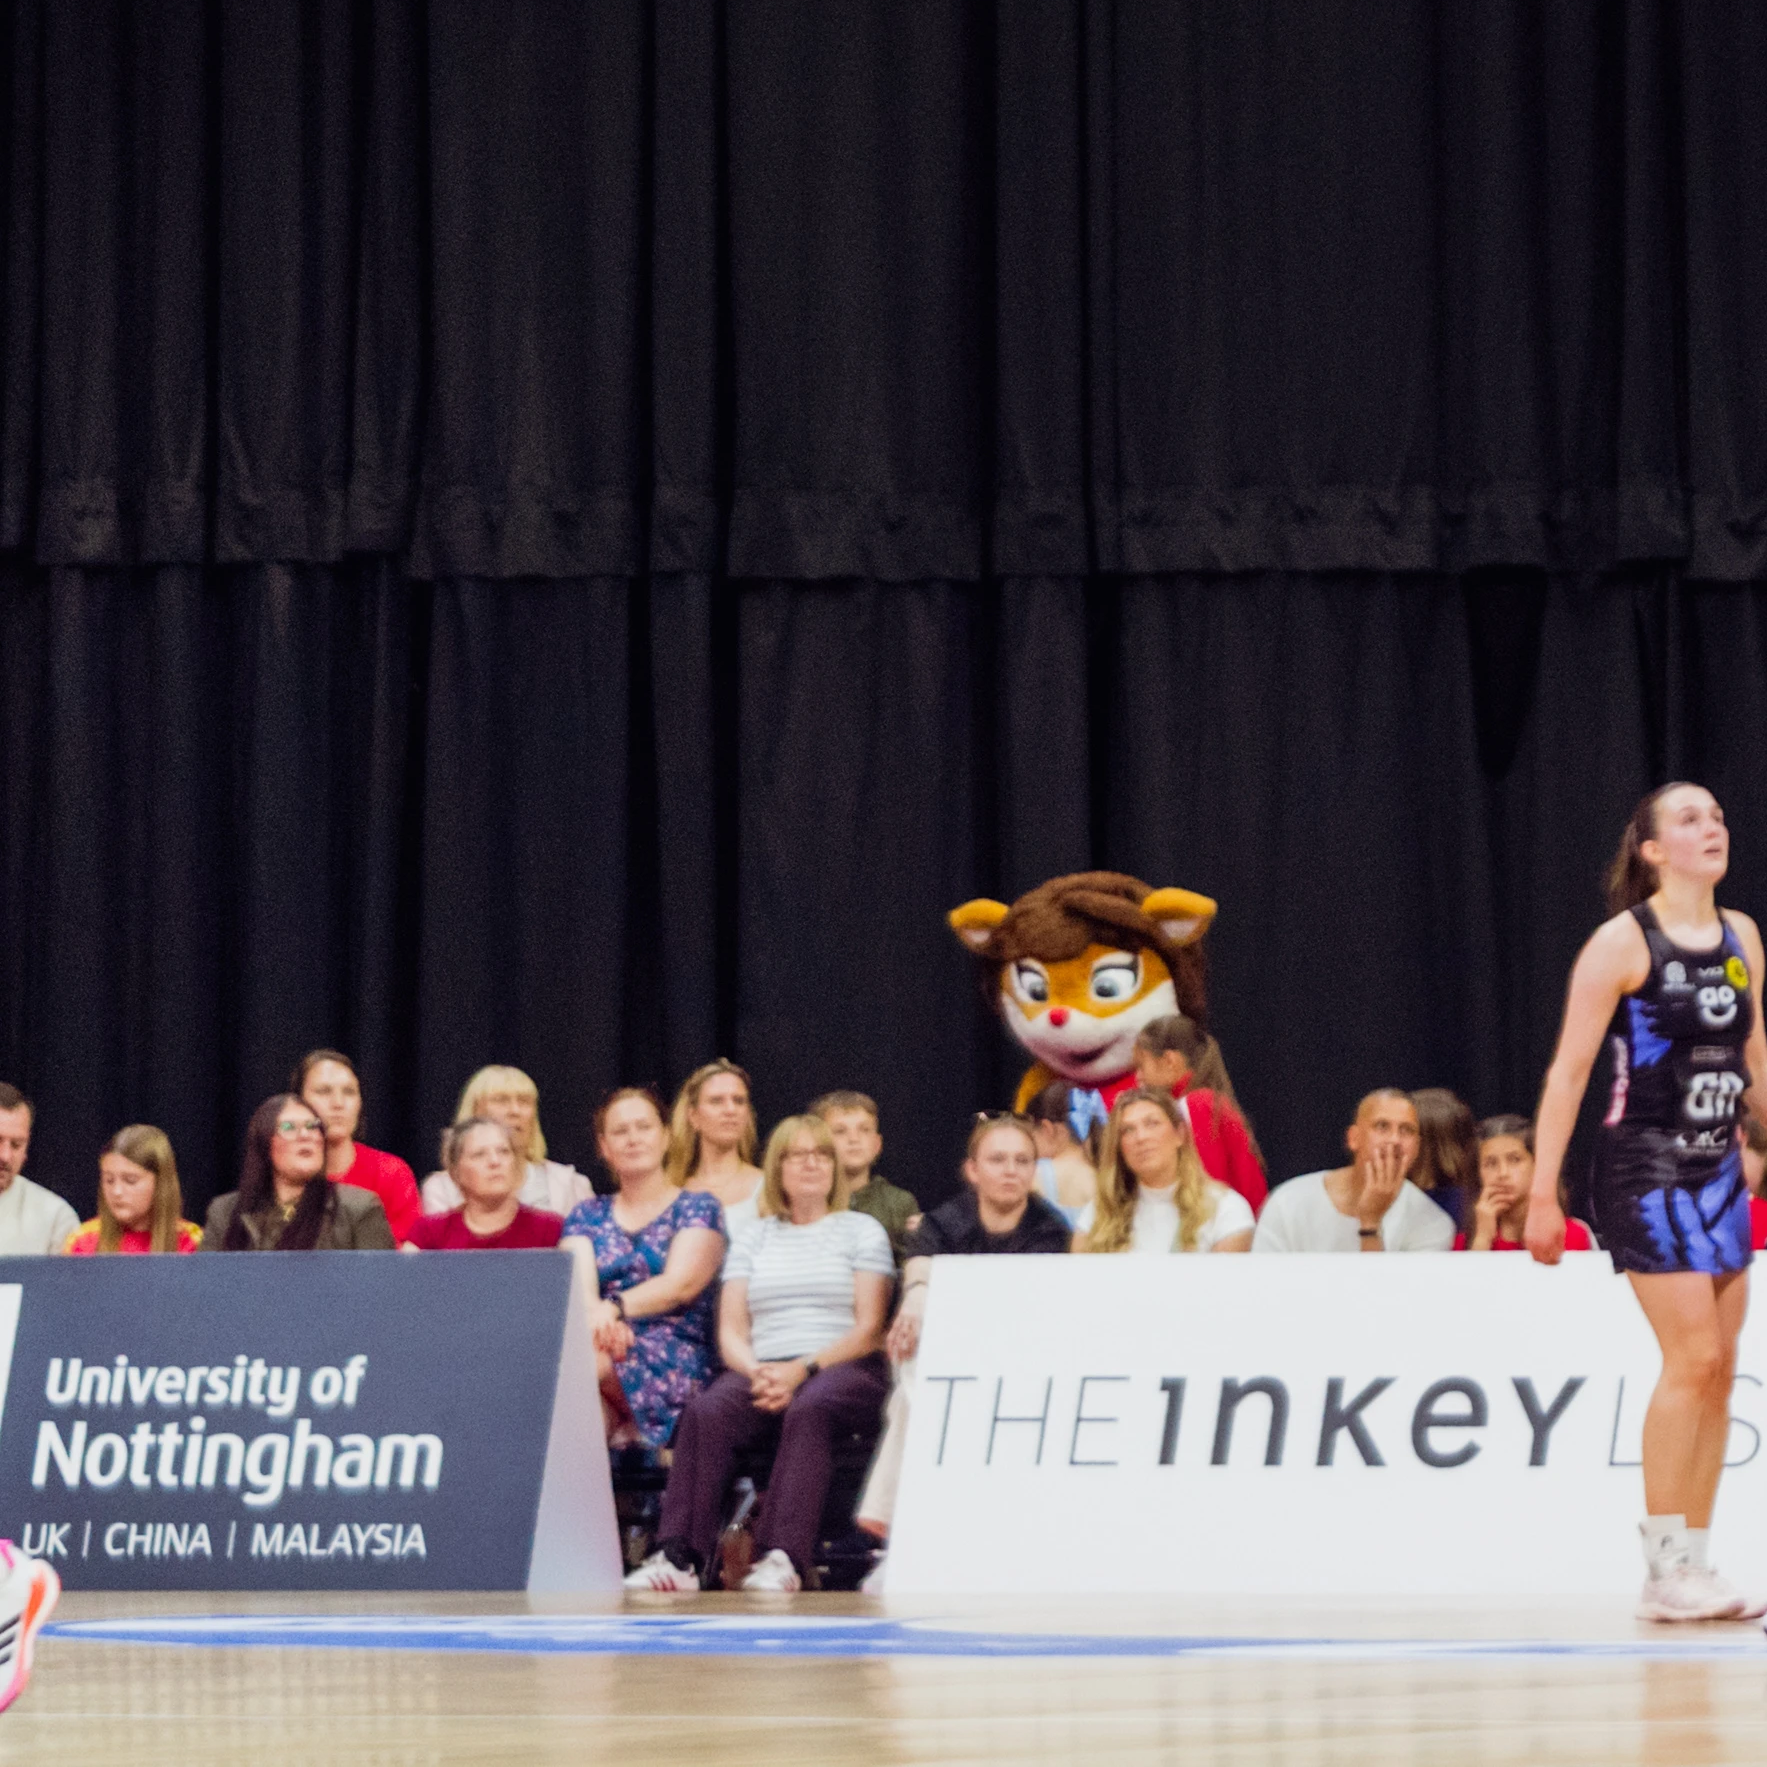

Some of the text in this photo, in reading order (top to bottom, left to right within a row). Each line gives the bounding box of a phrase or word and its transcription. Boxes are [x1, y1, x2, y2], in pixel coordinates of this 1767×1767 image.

[46, 1354, 369, 1417] University of
[926, 1375, 1132, 1466] THE
[31, 1415, 445, 1507] Nottingham
[22, 1522, 428, 1558] UK CHINA MALAYSIA
